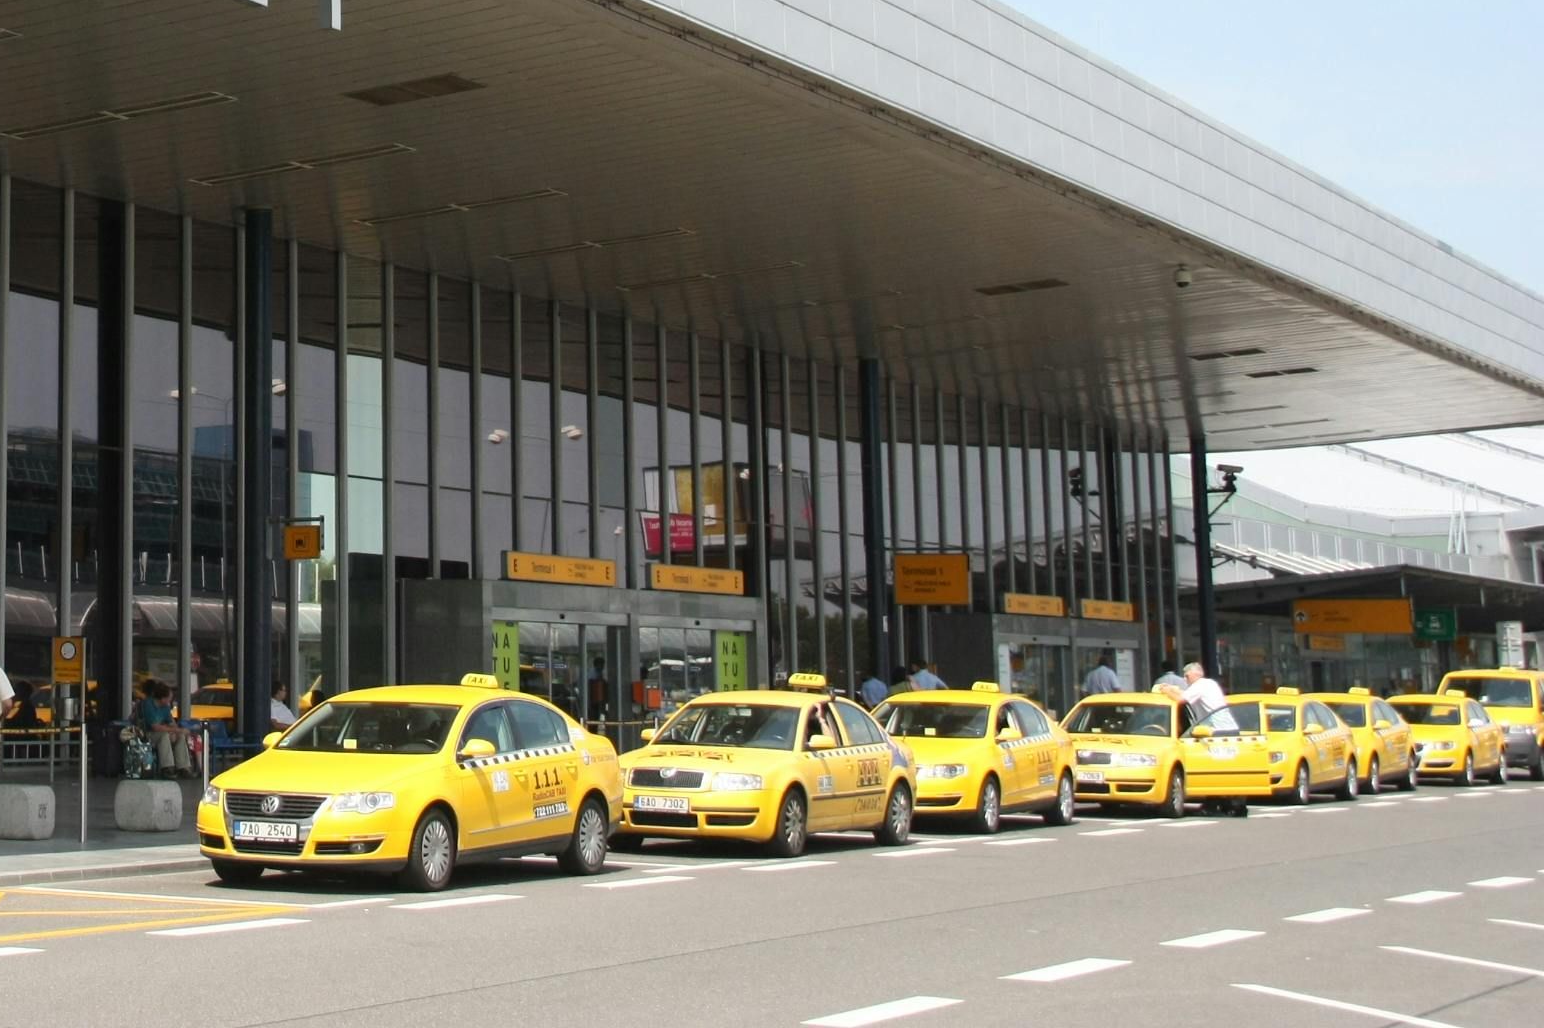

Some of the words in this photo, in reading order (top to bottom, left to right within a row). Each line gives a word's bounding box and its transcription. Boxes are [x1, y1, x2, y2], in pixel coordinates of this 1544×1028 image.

[513, 558, 518, 572] E
[531, 561, 552, 574] Terminal
[605, 566, 610, 580] E
[901, 566, 937, 576] Terminal
[939, 567, 944, 575] 1
[467, 675, 488, 684] TAXI
[794, 674, 819, 682] TAXI
[556, 787, 567, 796] TAXI
[662, 799, 685, 809] 7302
[267, 824, 292, 837] 2540
